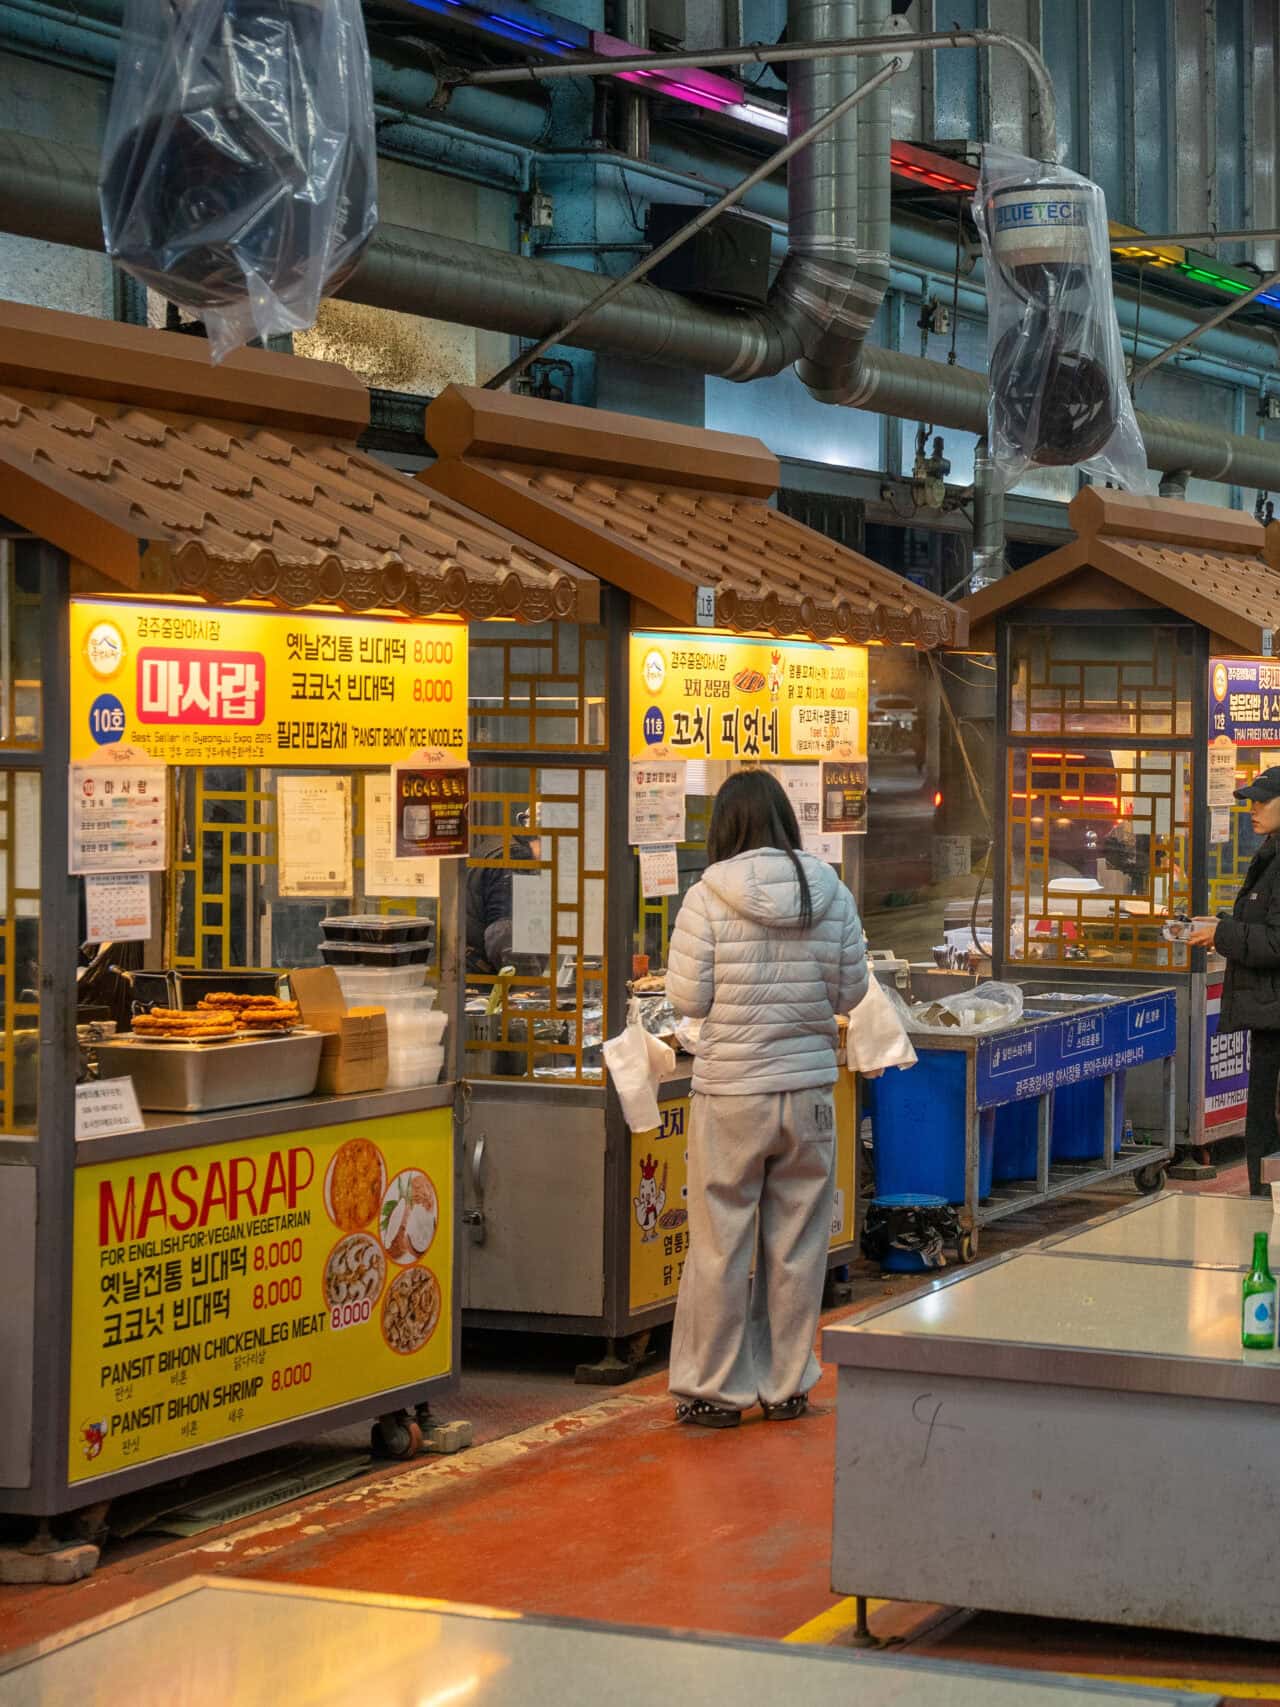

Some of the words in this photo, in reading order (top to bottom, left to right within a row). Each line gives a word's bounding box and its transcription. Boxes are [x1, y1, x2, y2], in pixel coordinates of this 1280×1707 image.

[137, 616, 221, 641] 경주중앙야시장
[286, 632, 354, 662] 옛날전통
[359, 636, 406, 665] 빈대떡
[413, 639, 453, 665] 8,000
[671, 651, 728, 672] 경주중앙야시장
[142, 658, 260, 720] 마사랍
[291, 672, 341, 701] 코코넛
[347, 675, 395, 703] 빈대떡
[412, 678, 453, 705] 8,000
[684, 678, 701, 698] 꼬치
[704, 679, 730, 698] 전문점
[93, 708, 125, 733] 10호
[1229, 693, 1261, 722] 볶음덮밥
[1262, 694, 1270, 721] &
[131, 731, 151, 744] Best
[154, 732, 180, 744] Seller
[277, 720, 348, 750] 필리핀잡채
[409, 727, 427, 748] RICE
[428, 728, 463, 748] NOODLES
[645, 716, 665, 736] 11호
[671, 704, 712, 755] 꼬치
[721, 707, 779, 756] 피었네
[1210, 1031, 1244, 1081] 볶음덮밥
[98, 1146, 316, 1247] MASARAP
[100, 1248, 125, 1269] FOR
[101, 1259, 184, 1308] 옛날전통
[191, 1245, 248, 1286] 빈대떡
[252, 1237, 303, 1272] 8,000
[103, 1304, 165, 1349] 코코넛
[173, 1289, 231, 1332] 빈대떡
[252, 1275, 303, 1310] 8,000
[101, 1354, 155, 1388] PANSIT
[158, 1345, 202, 1377] BIHON
[291, 1311, 327, 1340] MEAT
[330, 1299, 371, 1330] 8,000
[111, 1402, 164, 1437] PANSIT
[167, 1391, 210, 1422] BIHON
[212, 1376, 264, 1412] SHRIMP
[271, 1361, 313, 1392] 8,000
